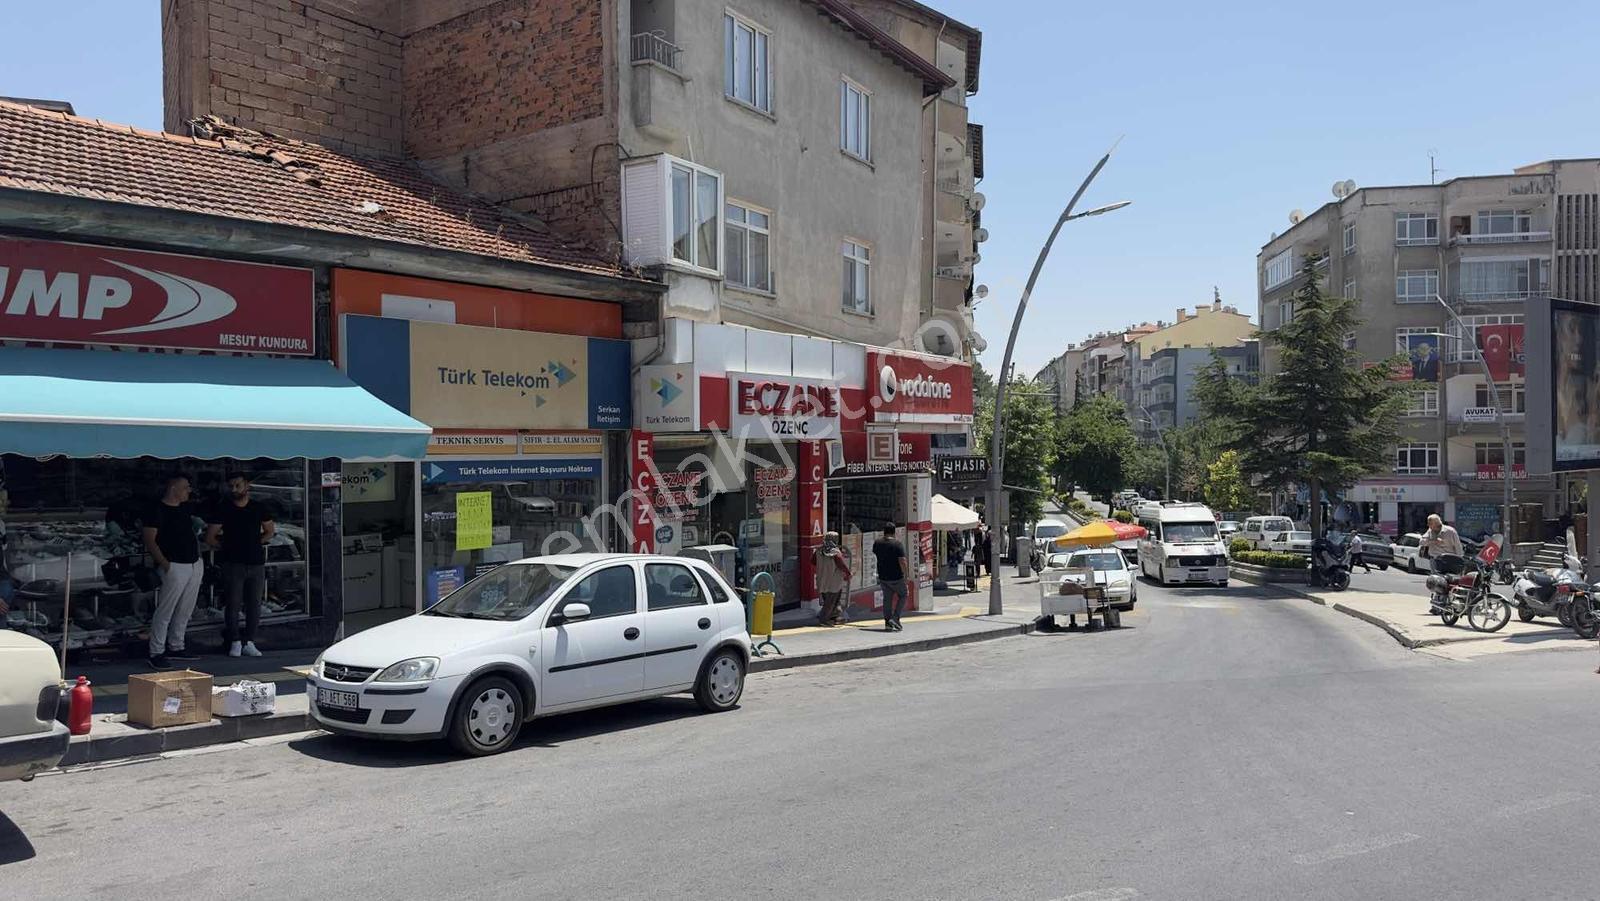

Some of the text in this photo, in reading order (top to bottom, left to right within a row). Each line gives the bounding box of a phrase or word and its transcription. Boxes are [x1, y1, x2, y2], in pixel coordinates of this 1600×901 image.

[0, 266, 132, 321] MP
[219, 334, 308, 350] MESUT KUNDURA
[438, 367, 549, 389] Türk Telekom
[899, 373, 952, 399] vodafone
[738, 380, 839, 417] ECZANE
[598, 405, 621, 414] Serkan
[646, 414, 690, 424] Türk Telekom
[772, 417, 808, 435] ÖZENÇ
[436, 436, 504, 445] TEKNİK SERVİS
[459, 465, 592, 475] Türk Telekom İnternet Başvuru Noktası
[954, 459, 985, 472] HASIR
[341, 475, 369, 484] ekom
[653, 471, 701, 488] ECZANE
[755, 467, 793, 482] ECZANE
[637, 440, 650, 553] ECZA
[757, 483, 791, 500] ÖZENÇ
